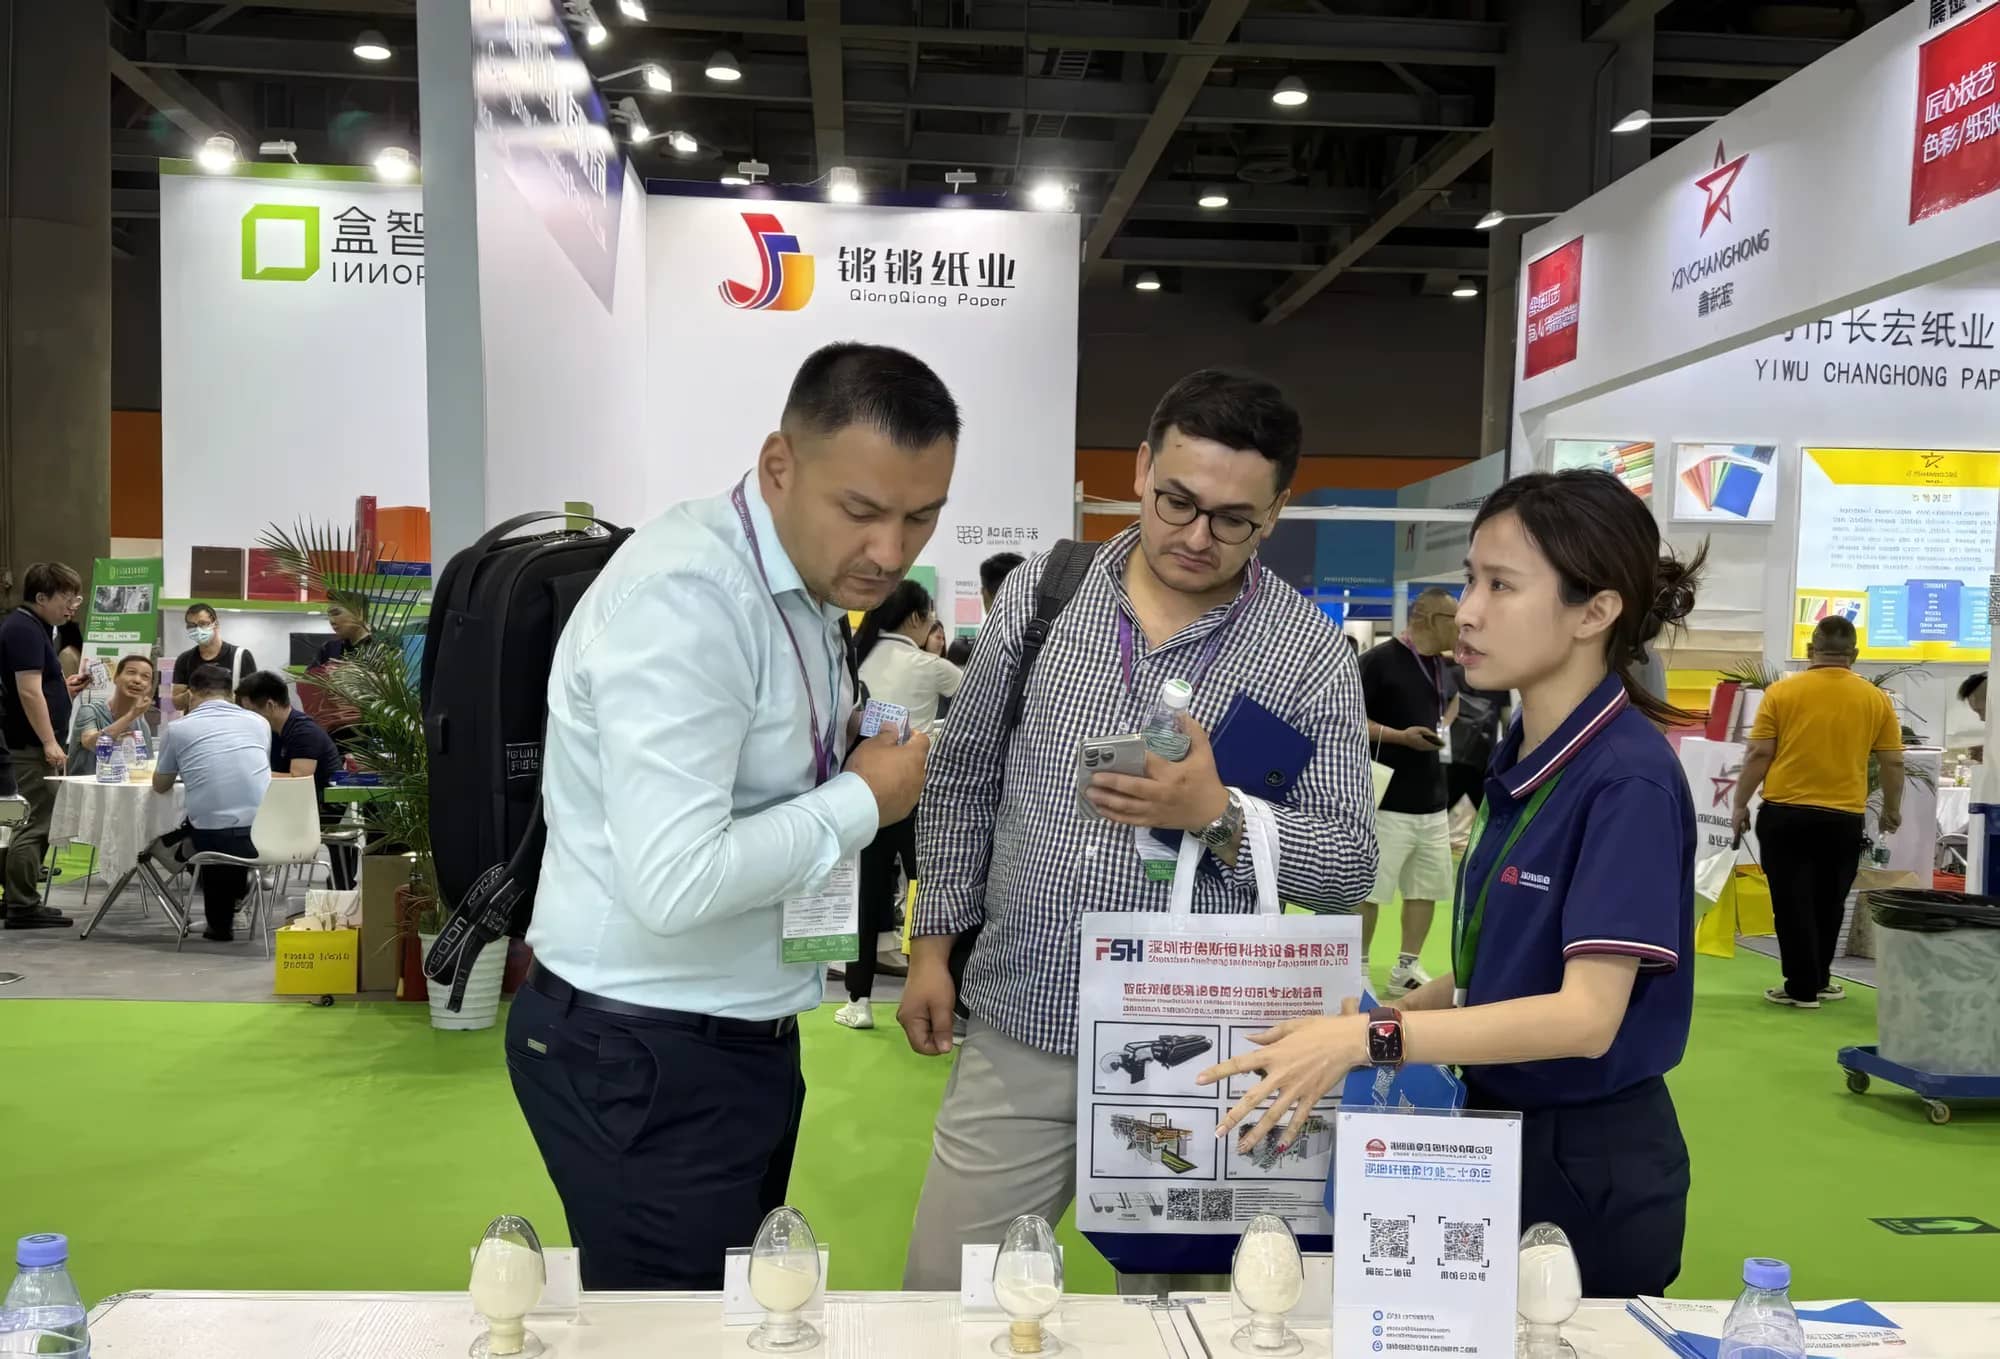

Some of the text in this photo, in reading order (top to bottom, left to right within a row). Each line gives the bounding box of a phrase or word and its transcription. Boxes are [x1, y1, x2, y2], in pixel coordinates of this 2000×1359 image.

[1925, 61, 1998, 123] 匠心技艺
[837, 246, 1016, 289] 锵锵纸业
[1784, 308, 1995, 350] 市长宏纸业
[1755, 358, 1809, 382] YIWU
[1823, 361, 1948, 388] CHANGHONG
[1095, 937, 1144, 963] FSH
